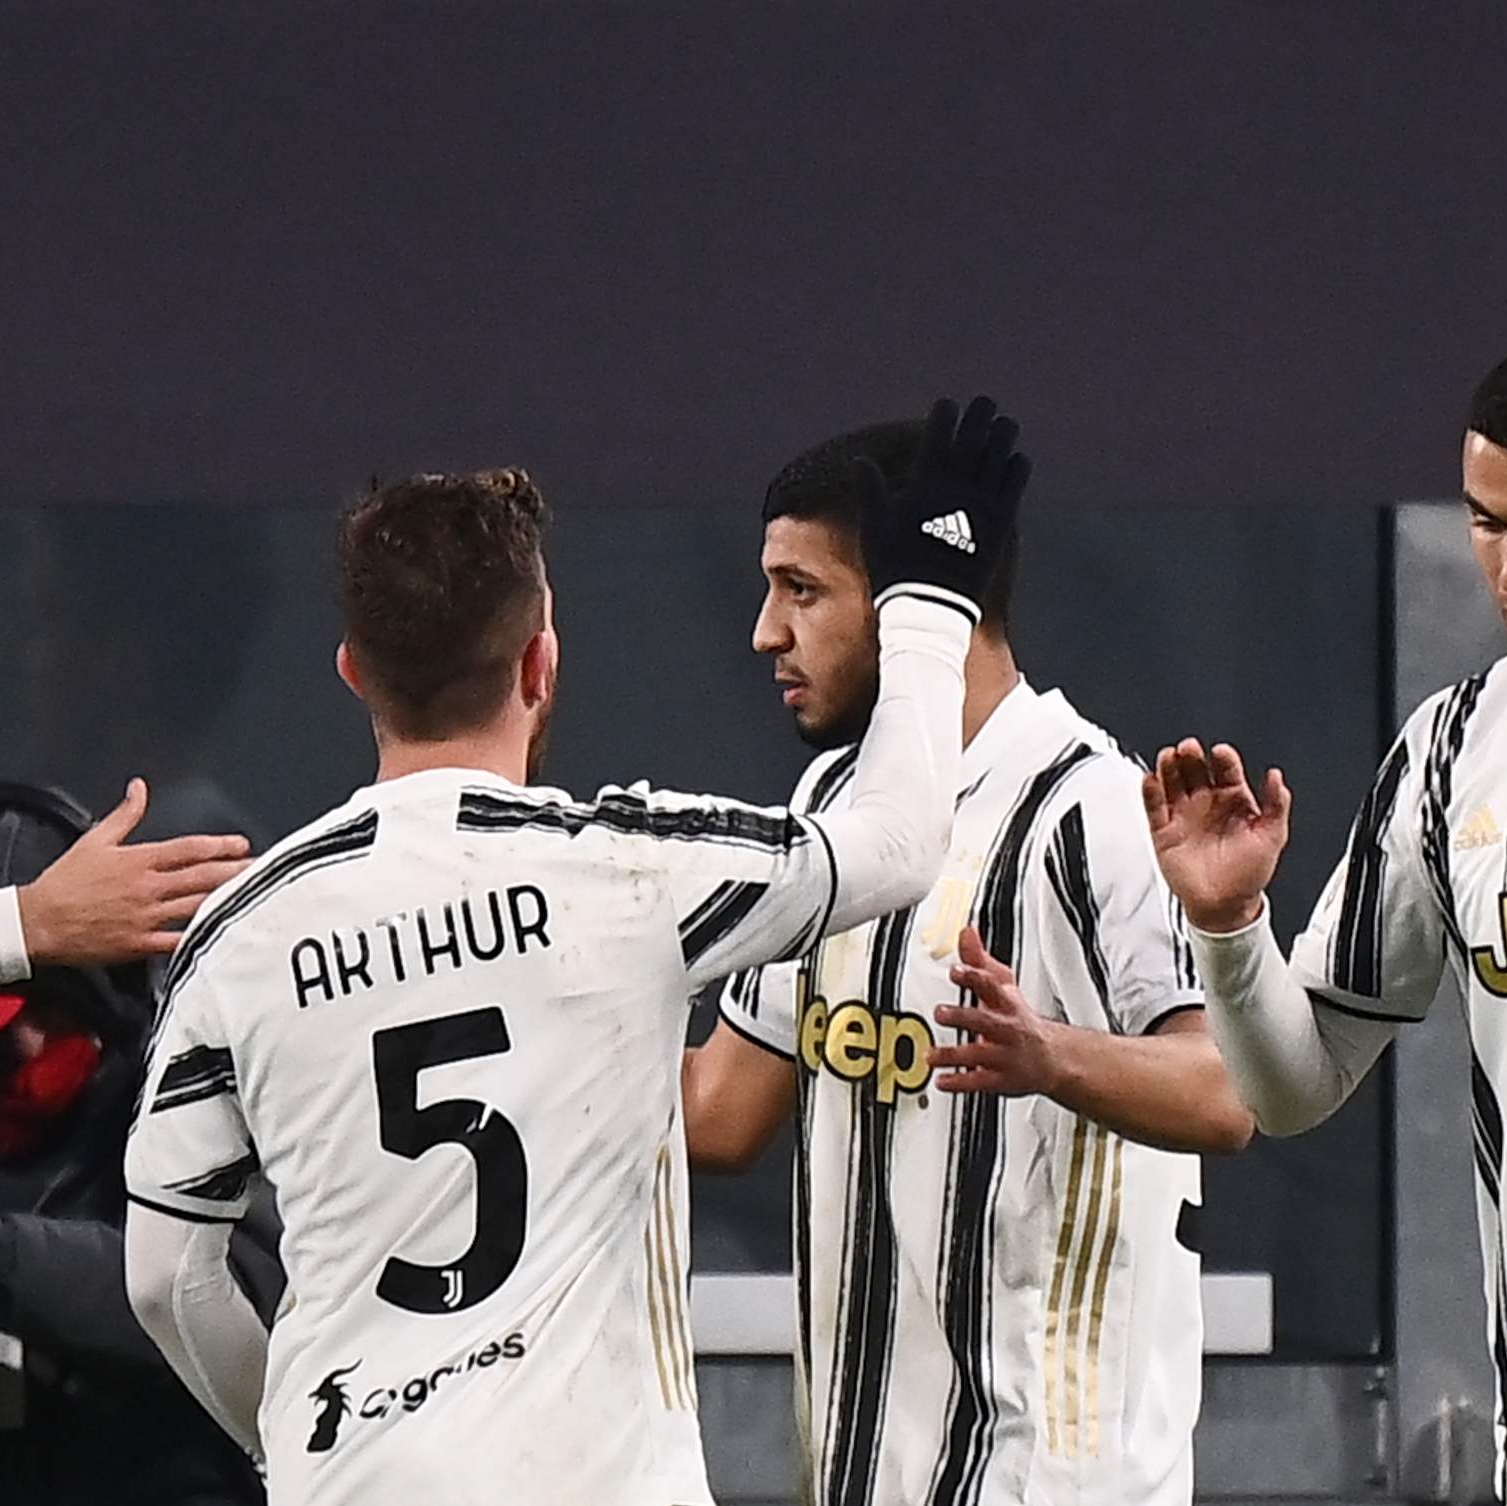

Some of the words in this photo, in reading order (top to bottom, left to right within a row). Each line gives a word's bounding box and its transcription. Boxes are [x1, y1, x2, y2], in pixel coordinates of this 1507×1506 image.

[921, 520, 976, 554] adidas
[292, 884, 551, 1008] ARTHUR
[797, 968, 936, 1105] eep
[372, 1005, 528, 1316] 5
